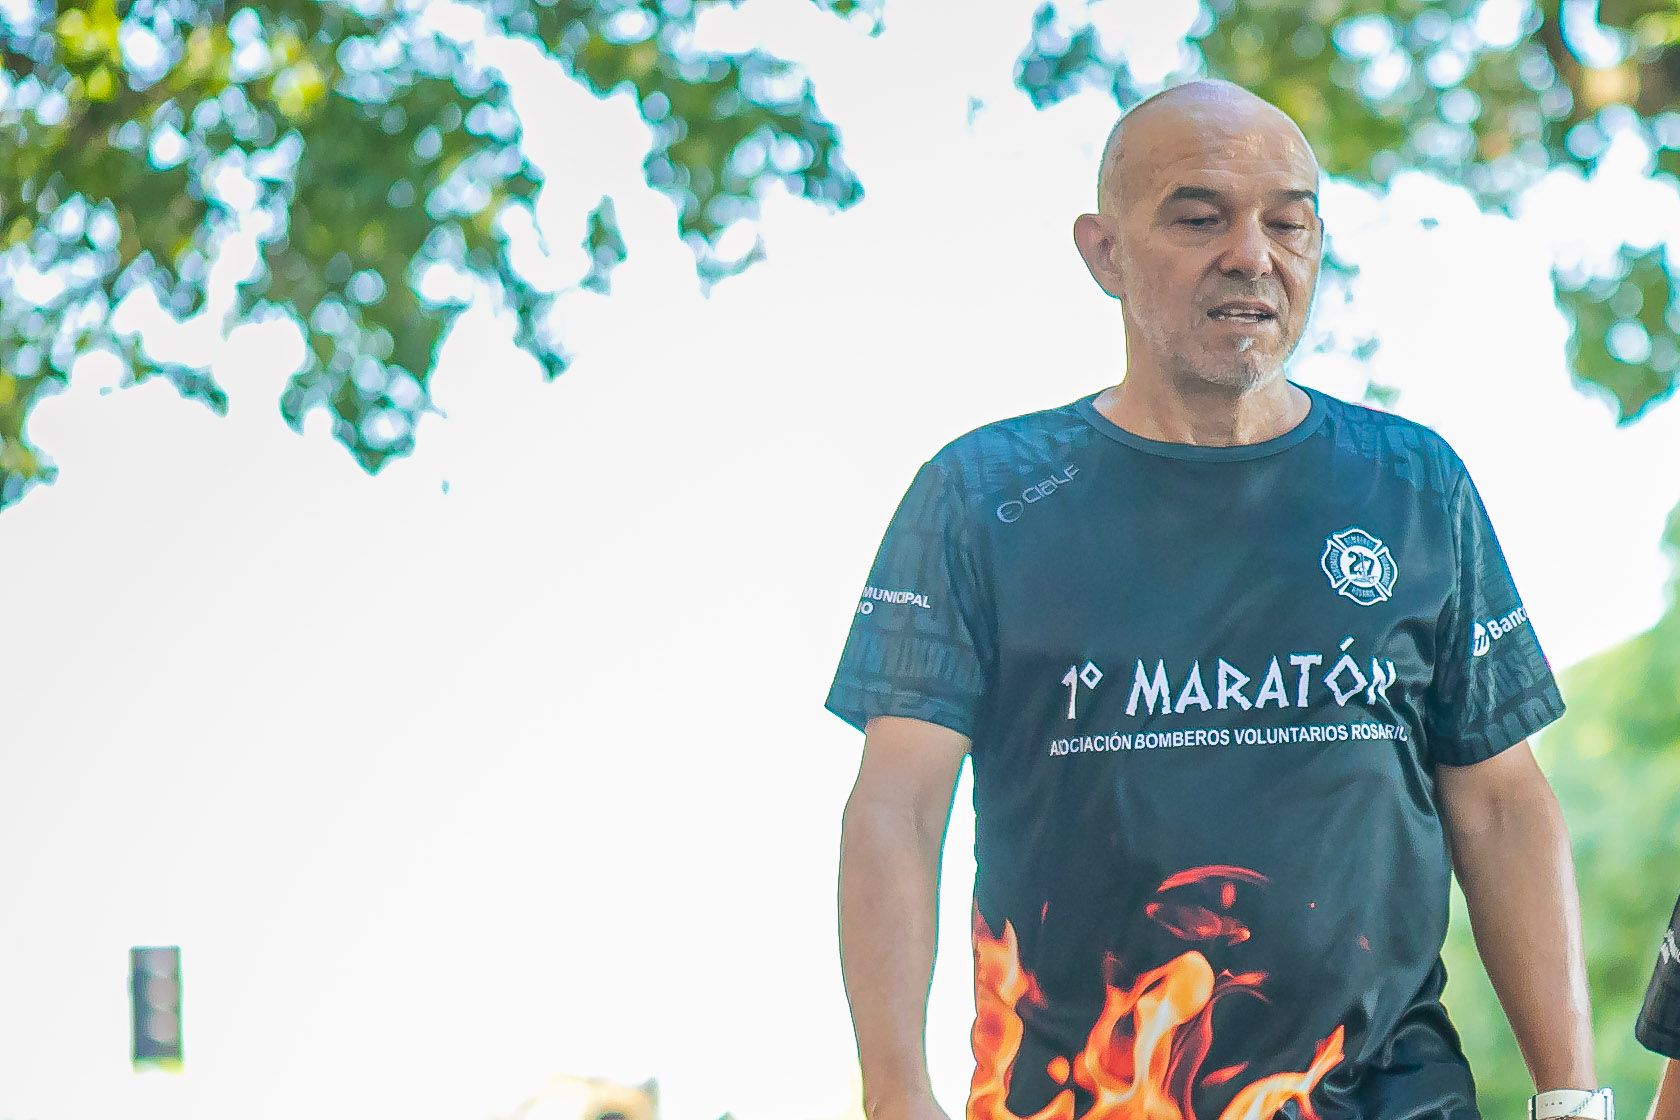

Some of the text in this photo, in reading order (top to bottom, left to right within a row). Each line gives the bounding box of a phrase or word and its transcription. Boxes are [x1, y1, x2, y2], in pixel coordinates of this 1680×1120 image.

[1347, 550, 1376, 578] 27
[1125, 635, 1397, 716] MARATÓN
[1049, 731, 1132, 757] AOCIACIÓN
[1134, 728, 1230, 750] BOMBEROS
[1234, 724, 1349, 746] VOLUNTARIOS
